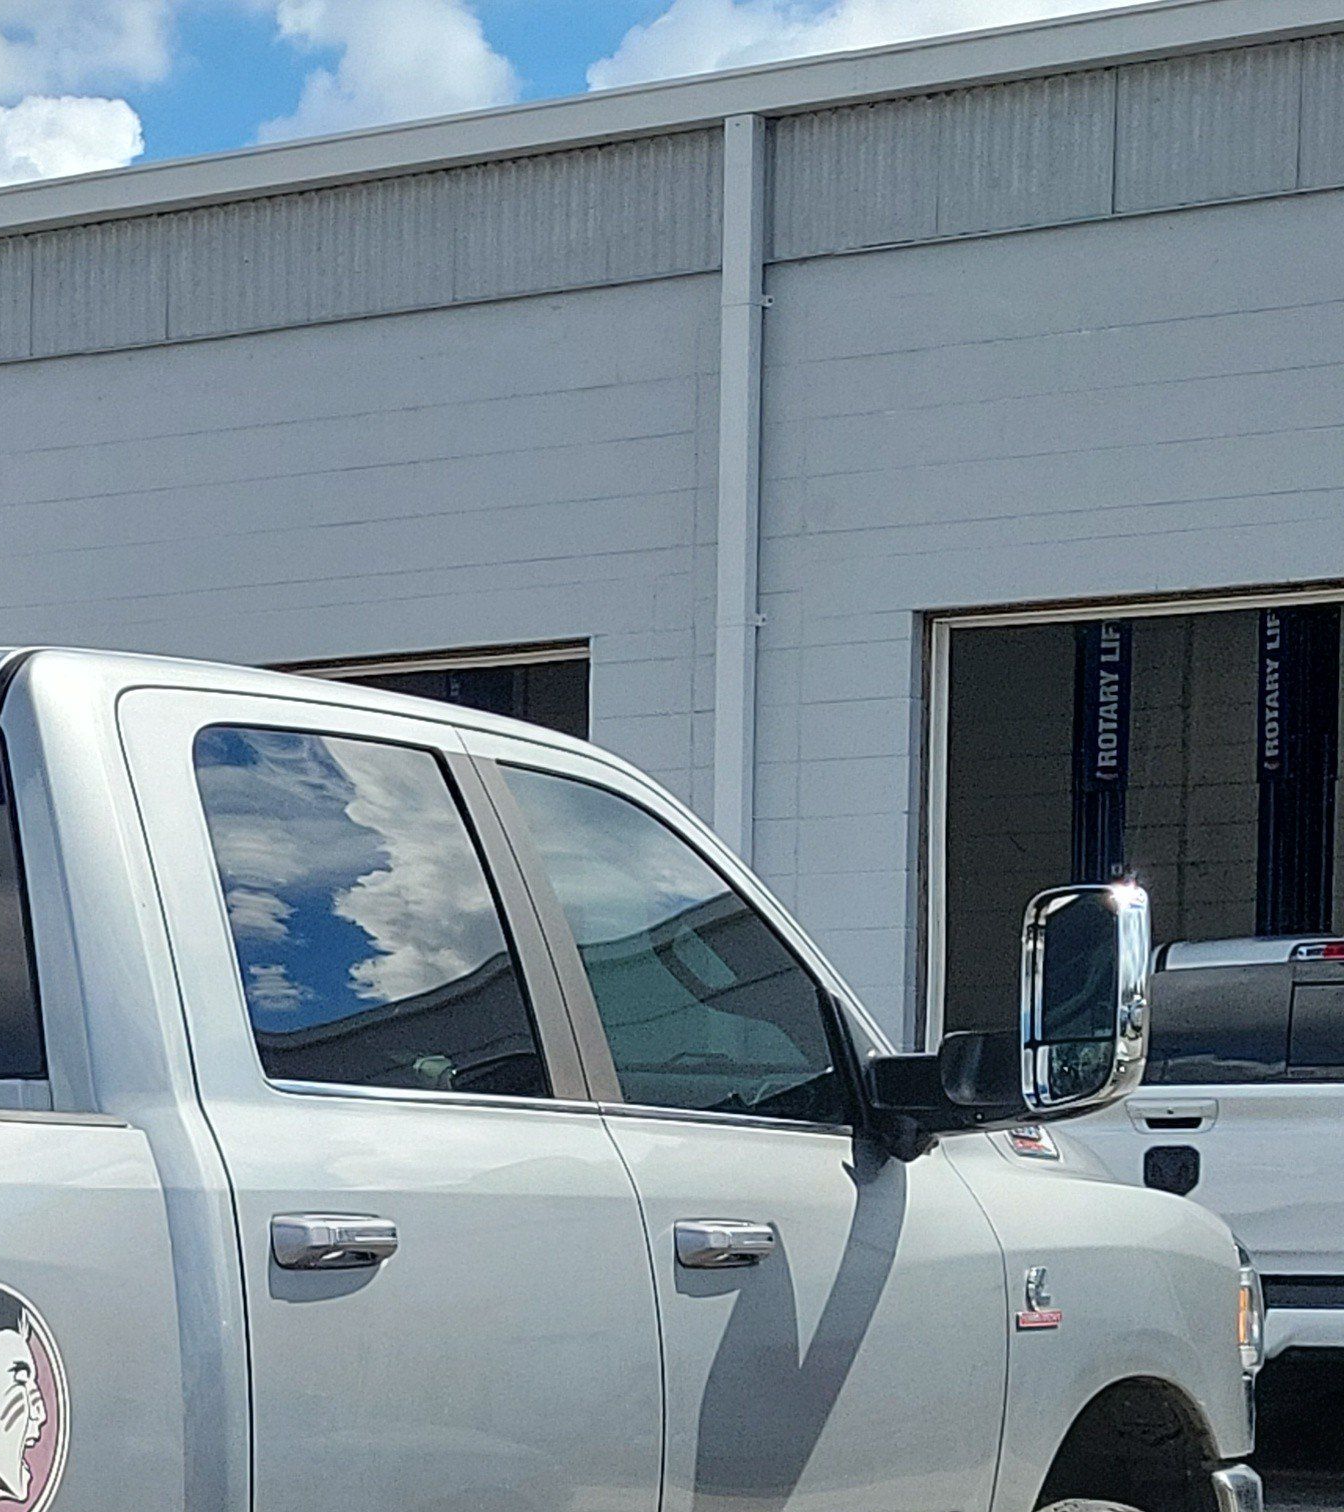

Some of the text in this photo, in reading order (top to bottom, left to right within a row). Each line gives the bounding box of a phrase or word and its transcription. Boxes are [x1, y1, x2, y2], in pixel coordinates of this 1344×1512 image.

[1097, 619, 1121, 768] ROTARY LIF
[1264, 608, 1281, 758] ROTARY LIF
